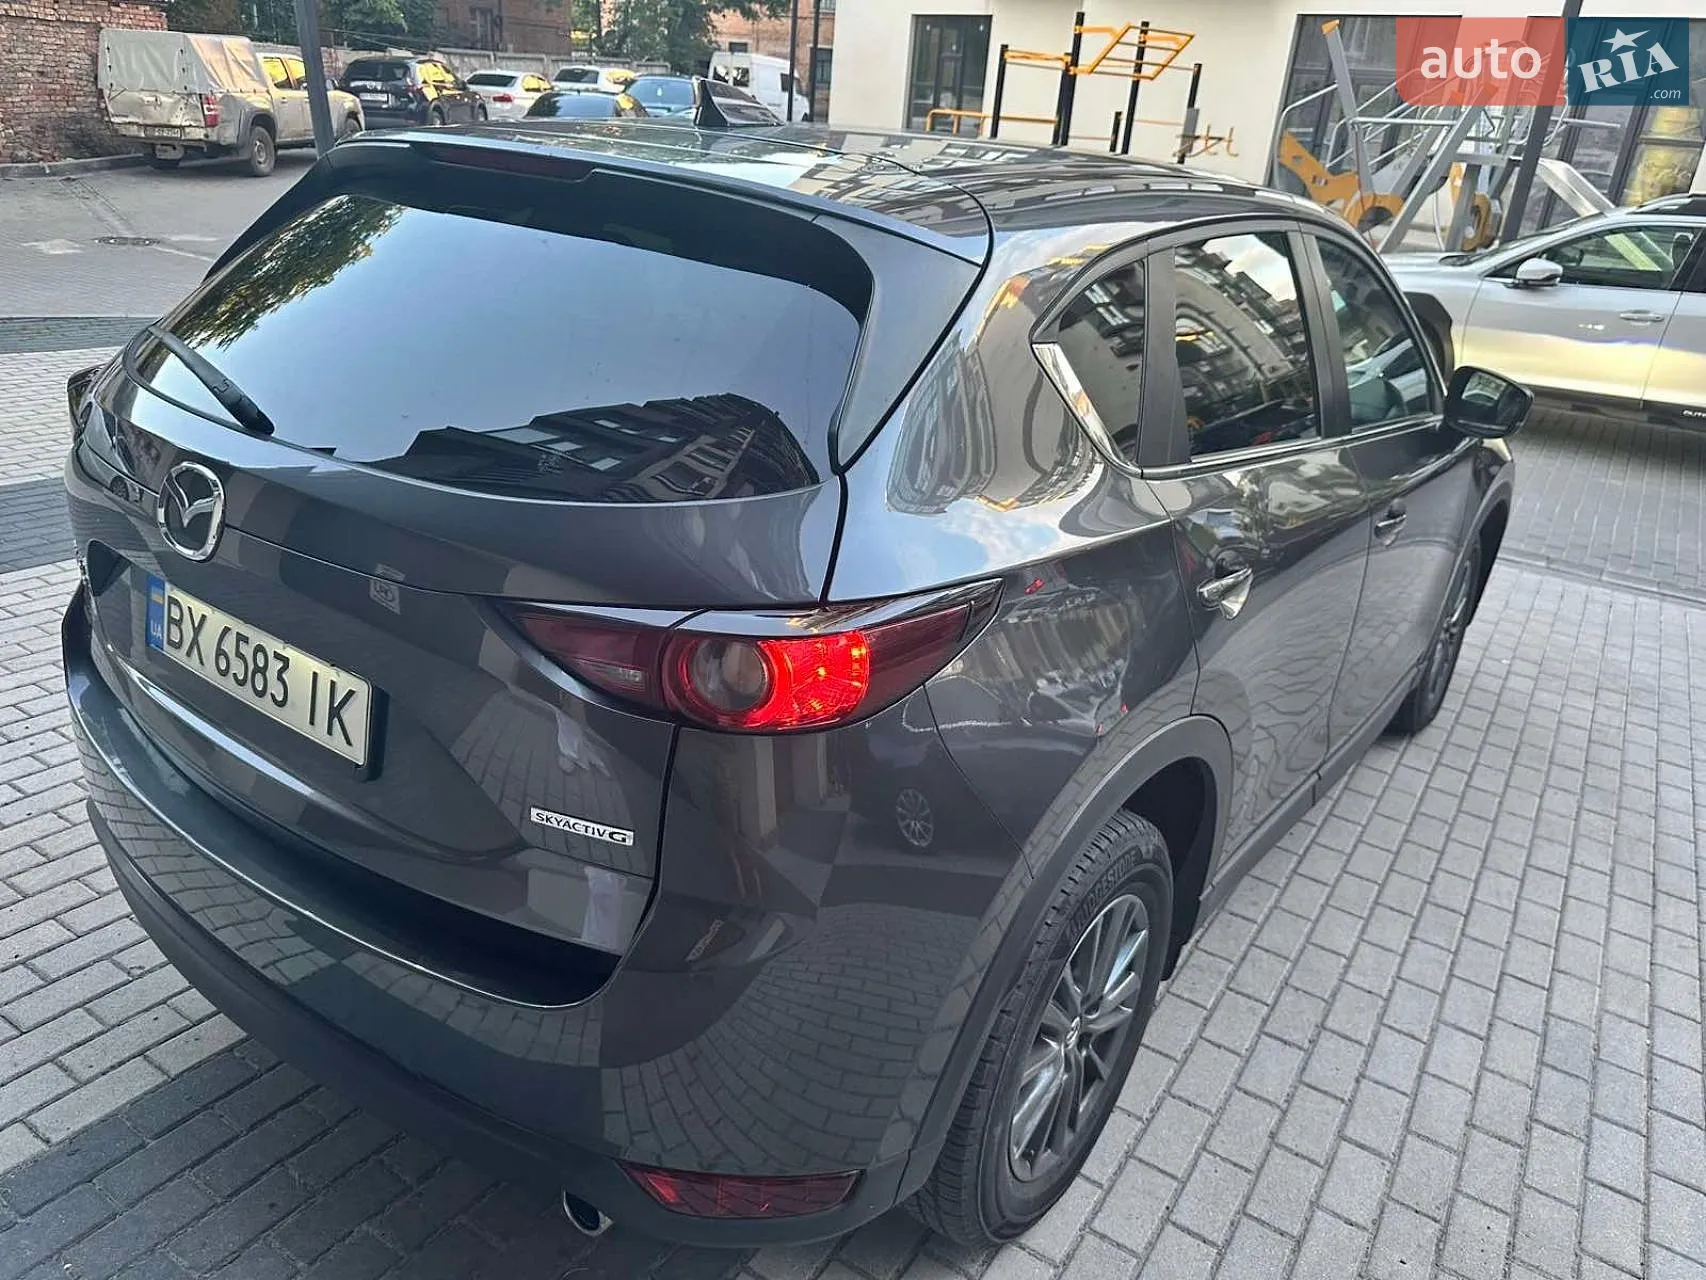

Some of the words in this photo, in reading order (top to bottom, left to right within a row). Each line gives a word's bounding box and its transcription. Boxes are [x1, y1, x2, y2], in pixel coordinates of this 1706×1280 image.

[150, 619, 163, 639] UA
[166, 595, 207, 666] BX
[214, 625, 291, 708] 6583
[308, 671, 356, 747] IK
